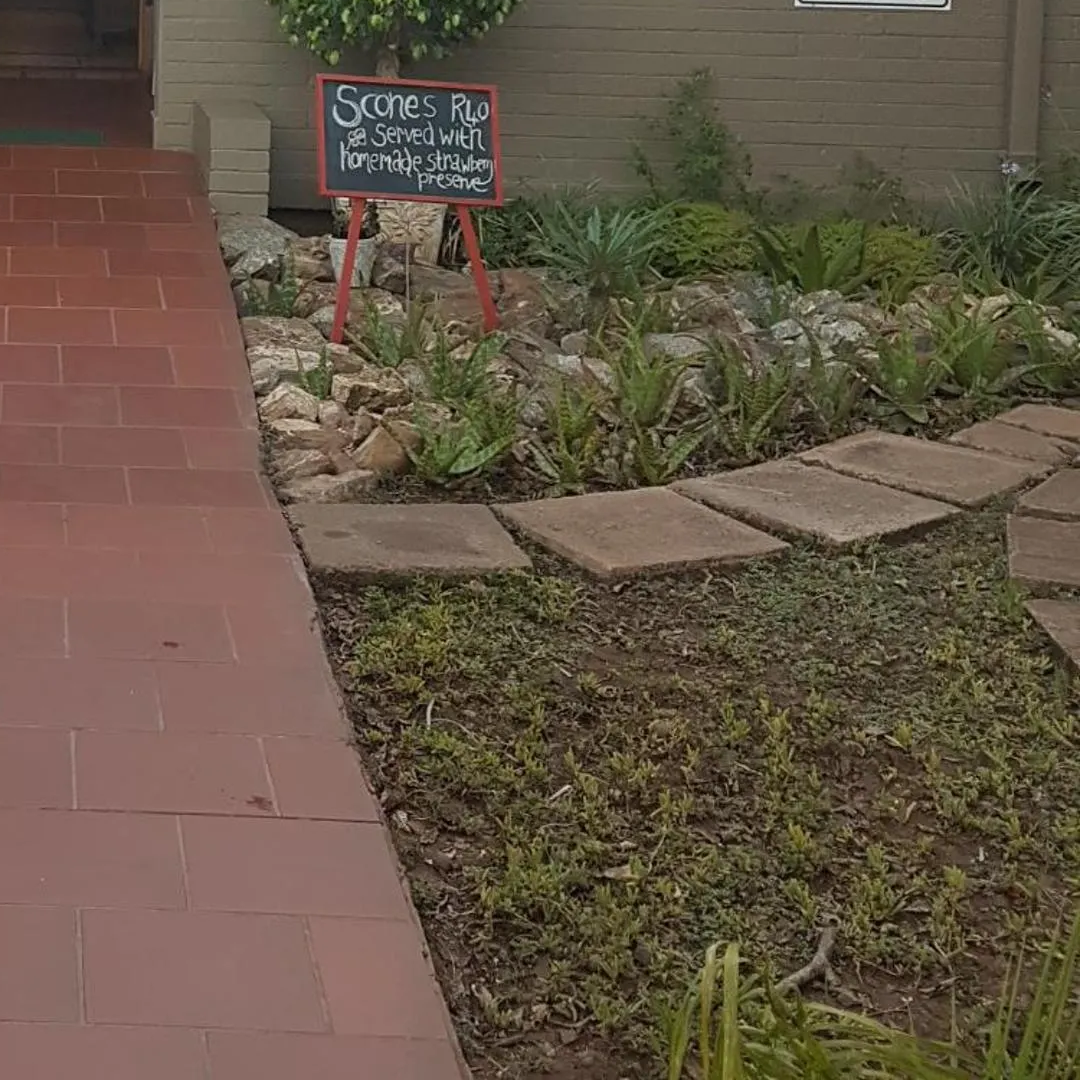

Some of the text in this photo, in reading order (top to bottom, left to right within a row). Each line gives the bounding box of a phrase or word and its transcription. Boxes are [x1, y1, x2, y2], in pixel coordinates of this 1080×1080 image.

[332, 85, 438, 128] Scones
[439, 125, 486, 151] with
[340, 141, 422, 177] homemade
